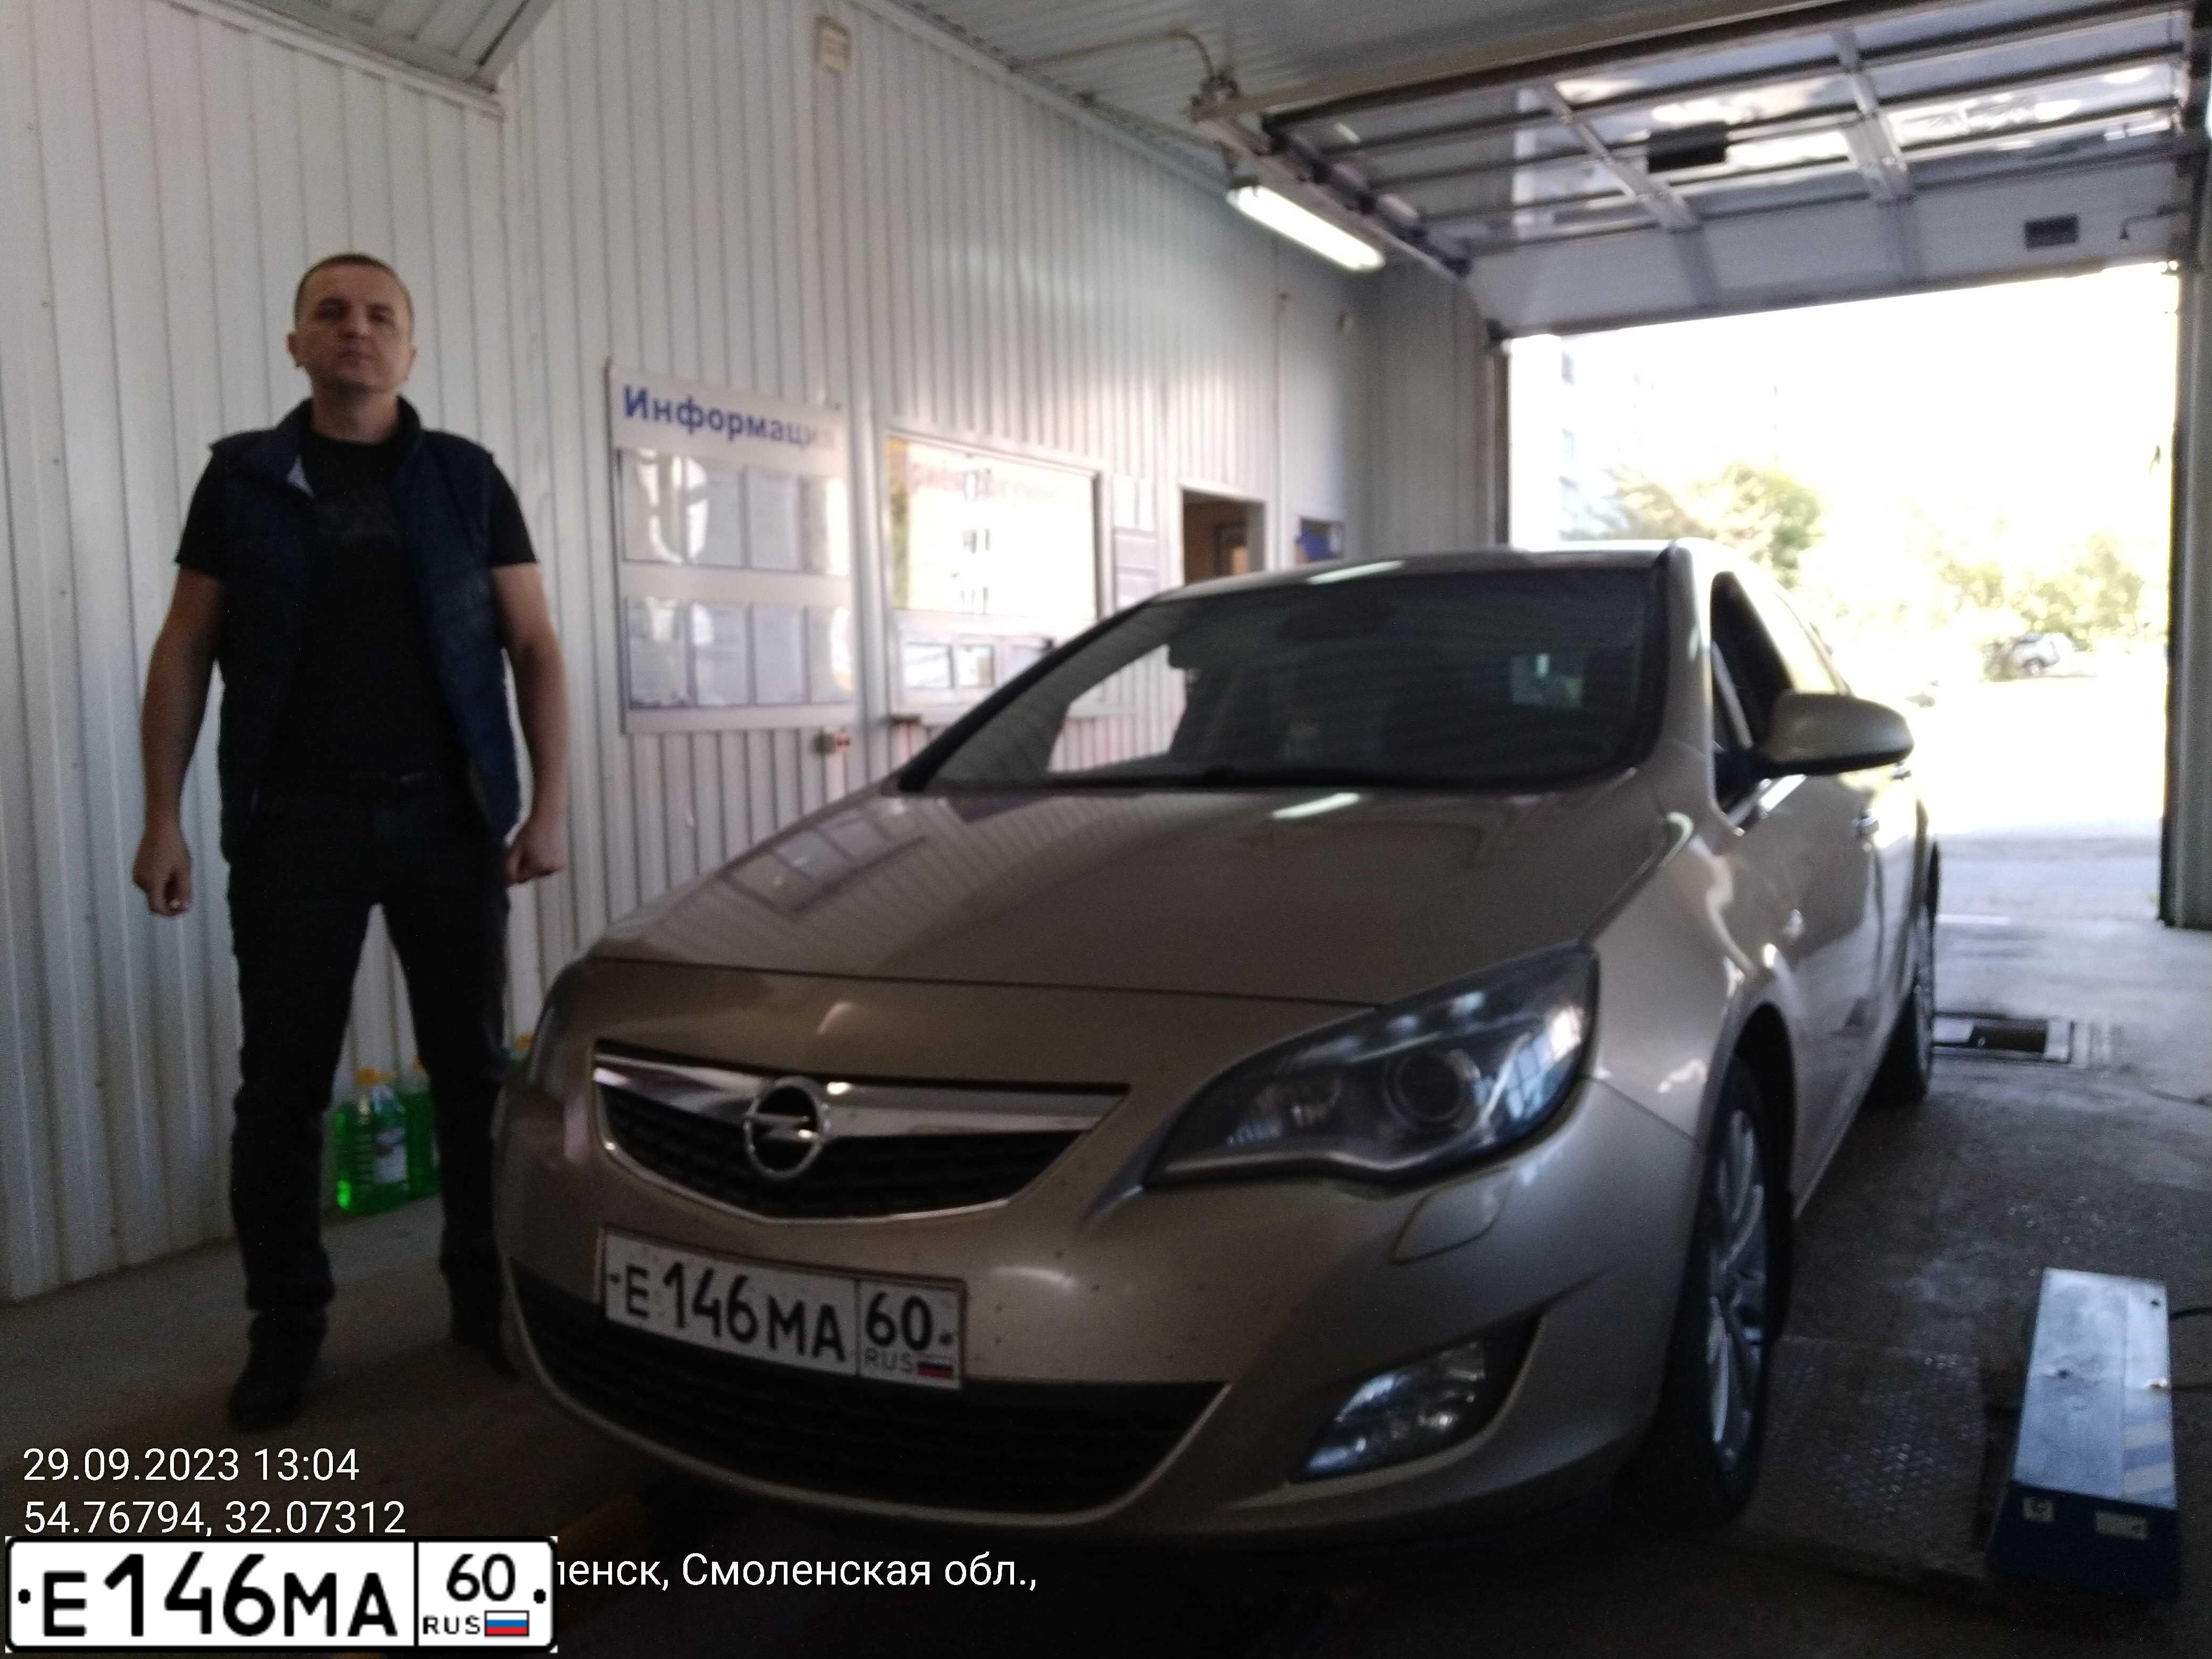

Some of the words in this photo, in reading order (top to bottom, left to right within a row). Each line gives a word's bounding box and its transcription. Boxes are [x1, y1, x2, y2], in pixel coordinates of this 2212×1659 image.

[623, 384, 836, 449] Информаци
[626, 1261, 847, 1362] Е146МА
[865, 1292, 933, 1351] 60
[865, 1348, 915, 1375] RUS
